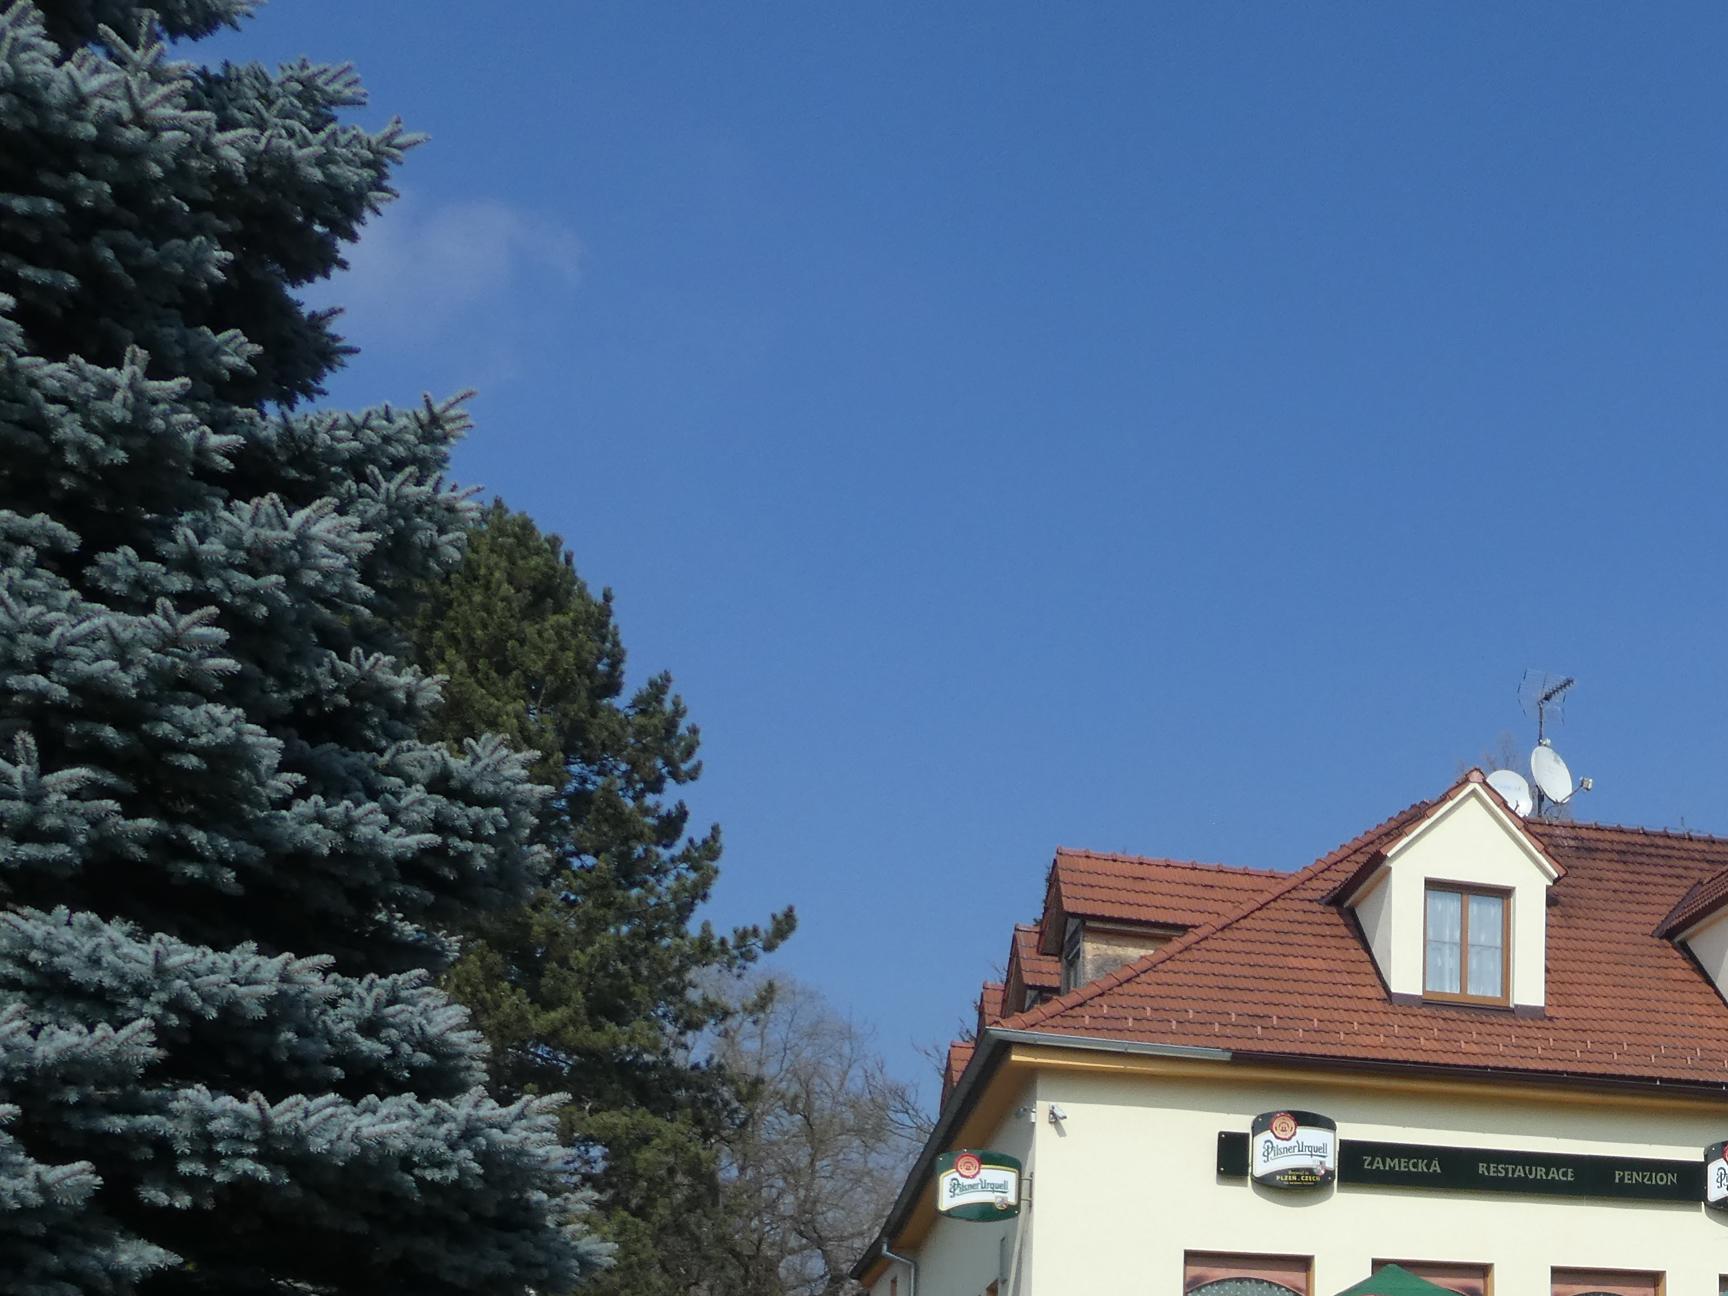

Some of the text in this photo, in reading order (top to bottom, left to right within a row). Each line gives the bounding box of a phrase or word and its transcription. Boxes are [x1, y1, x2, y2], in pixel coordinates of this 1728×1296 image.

[1262, 1139, 1329, 1163] Pilsner Urquell
[1478, 1162, 1576, 1182] RESTAURACE
[1614, 1169, 1679, 1186] PENZION
[949, 1177, 1009, 1198] Pilsner Urquell
